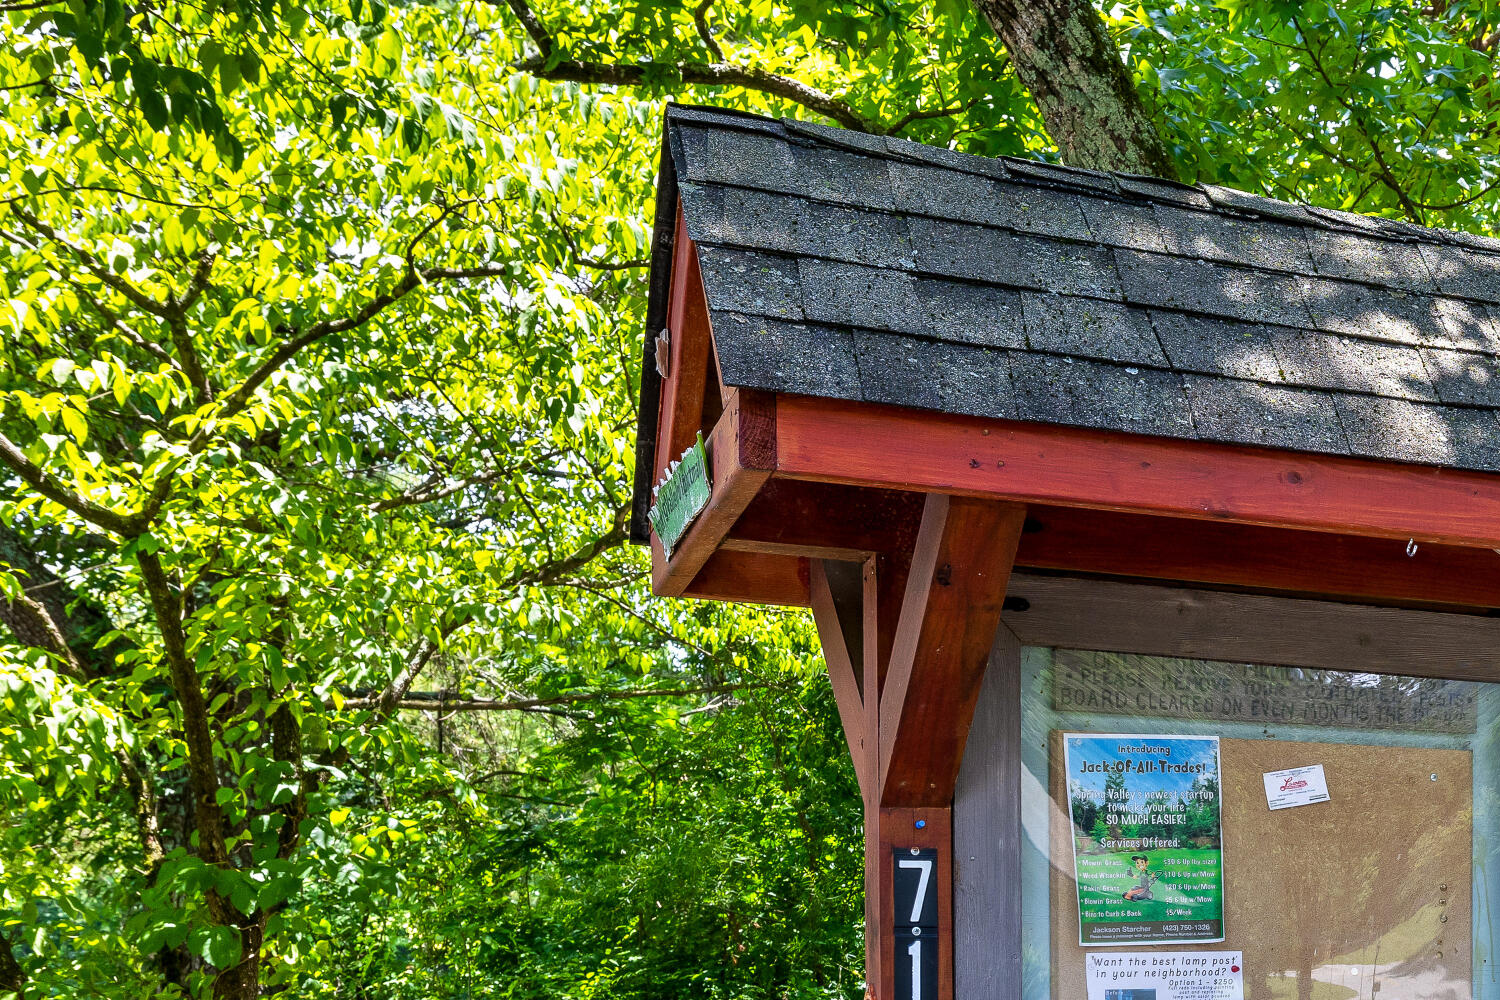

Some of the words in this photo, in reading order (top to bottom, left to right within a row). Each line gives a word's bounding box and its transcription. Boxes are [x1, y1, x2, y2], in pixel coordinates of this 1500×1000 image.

[1061, 686, 1128, 709] BOARD
[1136, 692, 1213, 712] CLEARED
[1221, 697, 1241, 714] ON
[1251, 699, 1294, 718] EVEN
[1304, 701, 1369, 721] MONTHS
[1118, 745, 1170, 756] Introducing
[1080, 759, 1206, 774] Jack-Of-All-Trades!
[1076, 790, 1105, 801] Spring
[1108, 789, 1142, 801] Valley's
[1145, 790, 1177, 799] newest
[1180, 790, 1214, 801] startup
[1108, 803, 1117, 812] to
[1118, 804, 1144, 812] make
[1147, 805, 1167, 814] your
[1170, 803, 1185, 812] life
[1106, 815, 1119, 825] SO
[1121, 815, 1149, 825] MUCH
[1151, 814, 1186, 825] EASIER!
[1100, 838, 1140, 848] Services
[1142, 837, 1180, 848] Offered:
[1092, 926, 1121, 934] Jackson
[1129, 957, 1147, 966] the
[1152, 956, 1176, 966] best
[1181, 956, 1207, 967] lamp
[1096, 969, 1107, 978] in
[1112, 970, 1139, 981] your
[1144, 967, 1227, 980] neighborhood?
[1169, 979, 1195, 988] Option
[1213, 978, 1234, 986] $250
